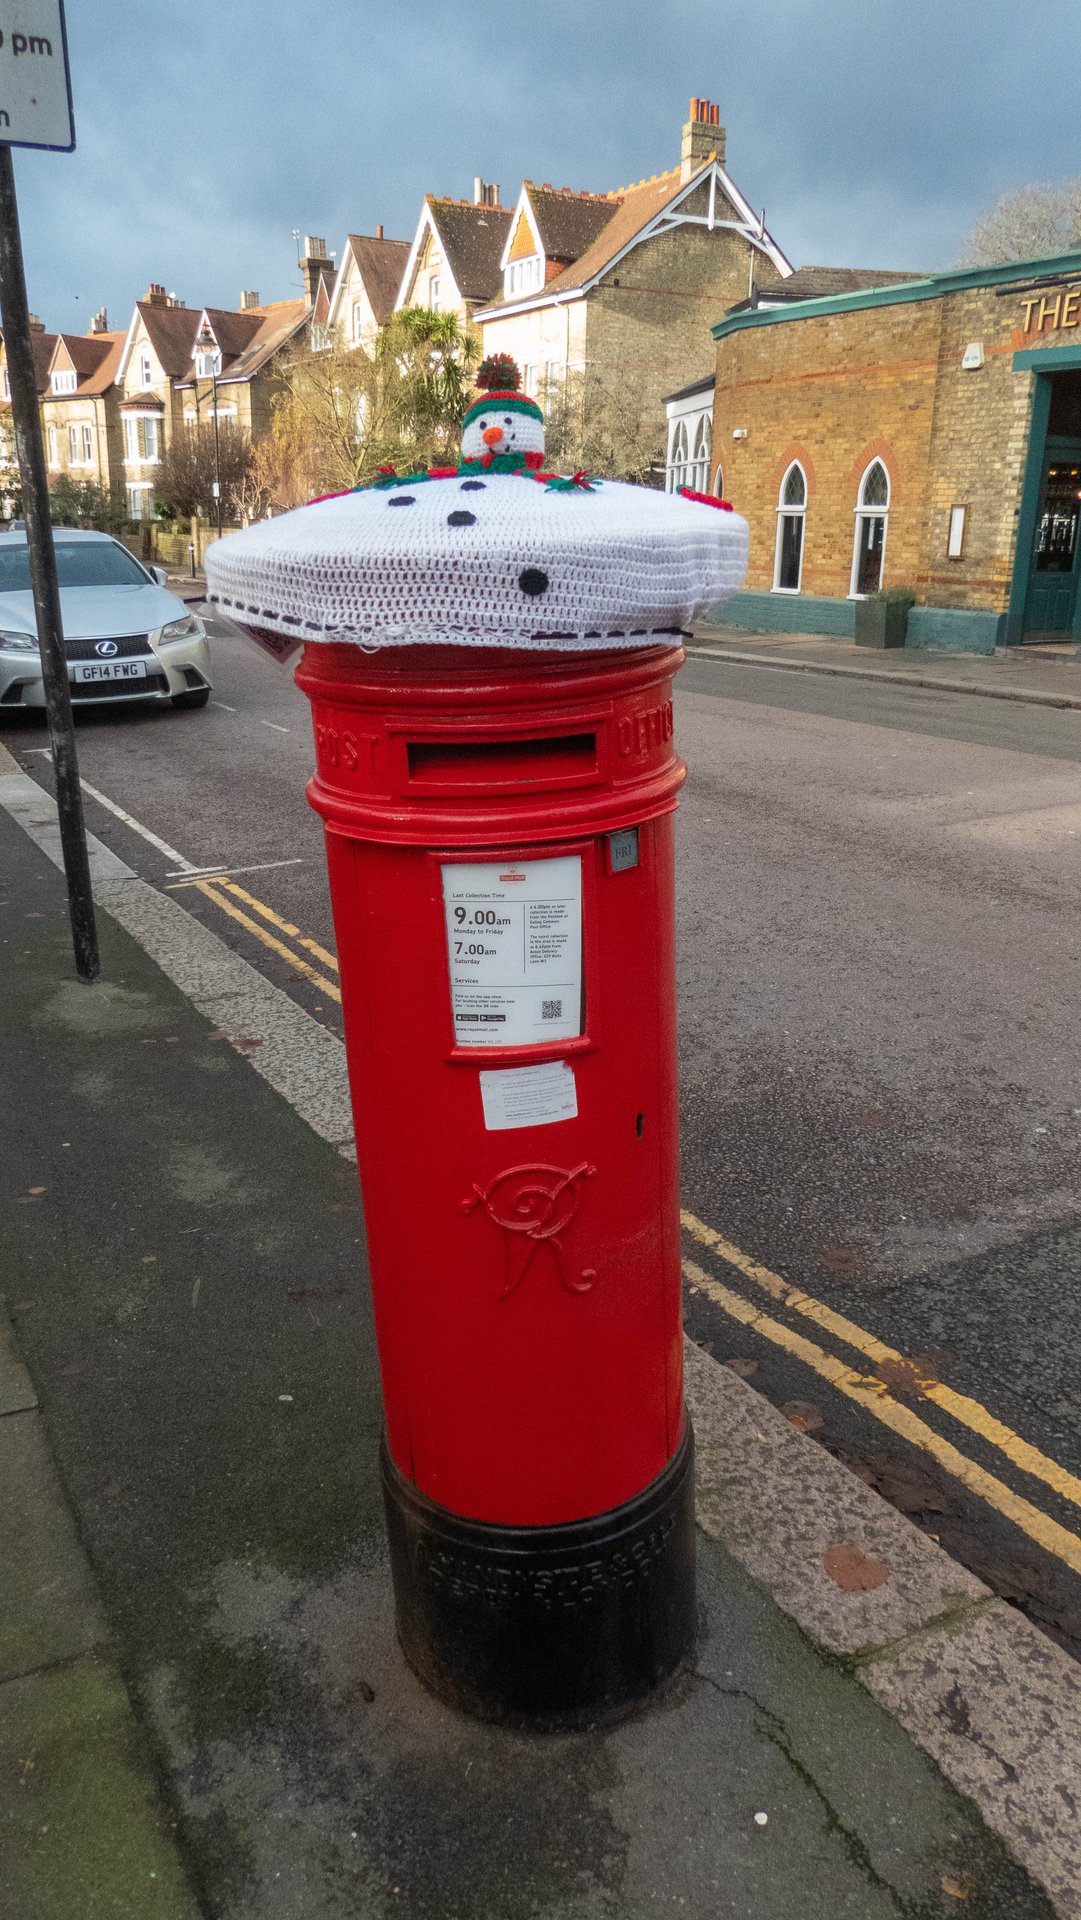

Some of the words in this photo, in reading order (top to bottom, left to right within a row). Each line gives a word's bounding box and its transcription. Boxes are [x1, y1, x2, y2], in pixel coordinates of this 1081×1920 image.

[12, 32, 52, 56] pm
[1021, 292, 1080, 332] THE
[83, 666, 111, 680] GF14
[114, 664, 138, 677] FWG
[615, 843, 632, 860] FRI
[454, 906, 511, 925] 9.00am
[454, 928, 476, 936] Monday
[485, 928, 504, 936] Friday
[454, 941, 497, 956] 7.00am
[454, 958, 480, 966] Saturday
